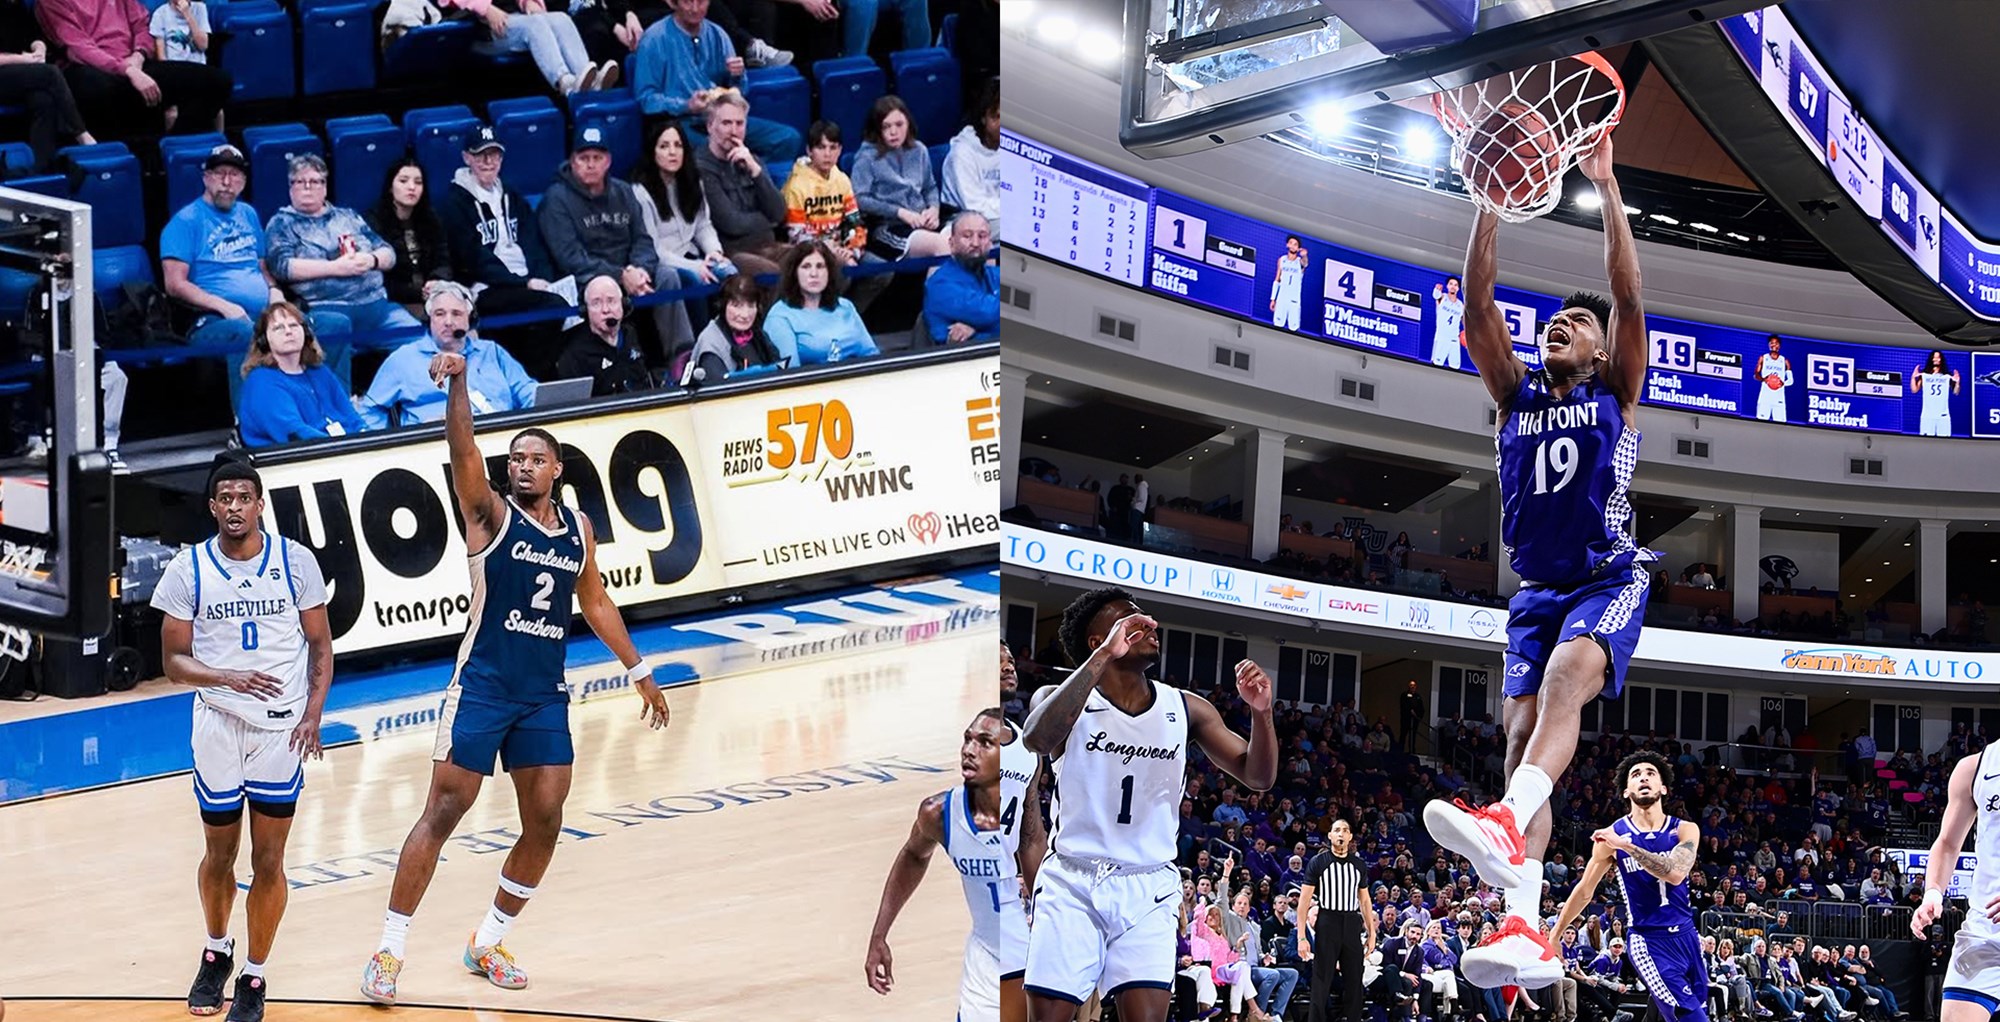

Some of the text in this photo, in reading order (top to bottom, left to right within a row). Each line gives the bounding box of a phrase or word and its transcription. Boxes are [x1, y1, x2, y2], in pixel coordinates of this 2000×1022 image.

[1799, 71, 1819, 118] 57
[1843, 113, 1867, 161] 5:18
[1020, 143, 1053, 166] POINT
[1031, 164, 1056, 180] Points
[1059, 175, 1098, 196] Rebounds
[1099, 190, 1128, 207] Assists
[1848, 170, 1861, 195] 2ND
[1034, 175, 1136, 220] 18 5 0 2
[1891, 182, 1909, 223] 66
[1033, 190, 1046, 204] 11
[1072, 205, 1080, 215] 2
[1107, 218, 1115, 228] 2
[1128, 225, 1135, 235] 2
[1032, 206, 1134, 250] 13 6 3 1
[1173, 218, 1186, 249] 1
[1034, 222, 1133, 264] 6 4 0 1
[1218, 241, 1244, 257] Guard
[1032, 238, 1132, 279] 4 0 2 1
[1153, 252, 1199, 281] Kezza
[1225, 258, 1237, 269] SR
[1968, 252, 1974, 267] 6
[1152, 270, 1188, 295] Giffa
[1338, 270, 1356, 299] 4
[1386, 288, 1410, 302] Guard
[1968, 279, 1974, 294] 2
[1324, 303, 1399, 336] D'Maurian
[1391, 305, 1403, 315] SR
[1505, 309, 1521, 336] 5
[1324, 319, 1388, 349] Williams
[1656, 338, 1691, 367] 19
[1704, 351, 1736, 363] Forward
[1649, 372, 1682, 389] Josh
[1713, 366, 1724, 375] FR
[1813, 360, 1849, 387] 55
[1866, 372, 1890, 381] Guard
[1649, 386, 1737, 412] Ibukunoluwa
[1872, 386, 1883, 394] SR
[1930, 384, 1943, 396] 55
[1808, 395, 1851, 412] Bobby
[1989, 408, 2000, 424] 5
[1548, 402, 1599, 431] POINT
[1808, 410, 1868, 428] Pettiford
[767, 399, 854, 470] 570
[723, 437, 763, 459] NEWS
[856, 450, 872, 459] am
[723, 455, 764, 477] RADIO
[1533, 437, 1579, 495] 19
[824, 465, 913, 503] WWNC
[511, 541, 580, 573] Charleston
[763, 538, 827, 567] LISTEN
[831, 532, 873, 555] LIVE
[877, 526, 906, 547] ON
[1008, 536, 1179, 588] TO GROUP
[531, 572, 555, 611] 2
[1201, 590, 1242, 603] HONDA
[206, 598, 286, 620] ASHEVILLE
[1263, 600, 1310, 614] CHEVROLET
[1328, 599, 1379, 615] GMC
[241, 621, 258, 651] 0
[504, 609, 565, 640] Southern
[1400, 621, 1436, 632] BUICK
[1467, 619, 1498, 629] NISSAN
[1309, 652, 1328, 666] 107
[1783, 649, 1983, 679] Vann York AUTO
[1468, 672, 1486, 685] 106
[1762, 699, 1782, 712] 106
[1901, 708, 1920, 719] 105
[1086, 731, 1180, 765] Longwood
[587, 754, 954, 827] MISSION
[1117, 775, 1134, 824] 1
[1986, 794, 2000, 812] L
[1919, 856, 1977, 869] 5 66
[1656, 879, 1670, 907] 1
[1695, 890, 1702, 899] 6
